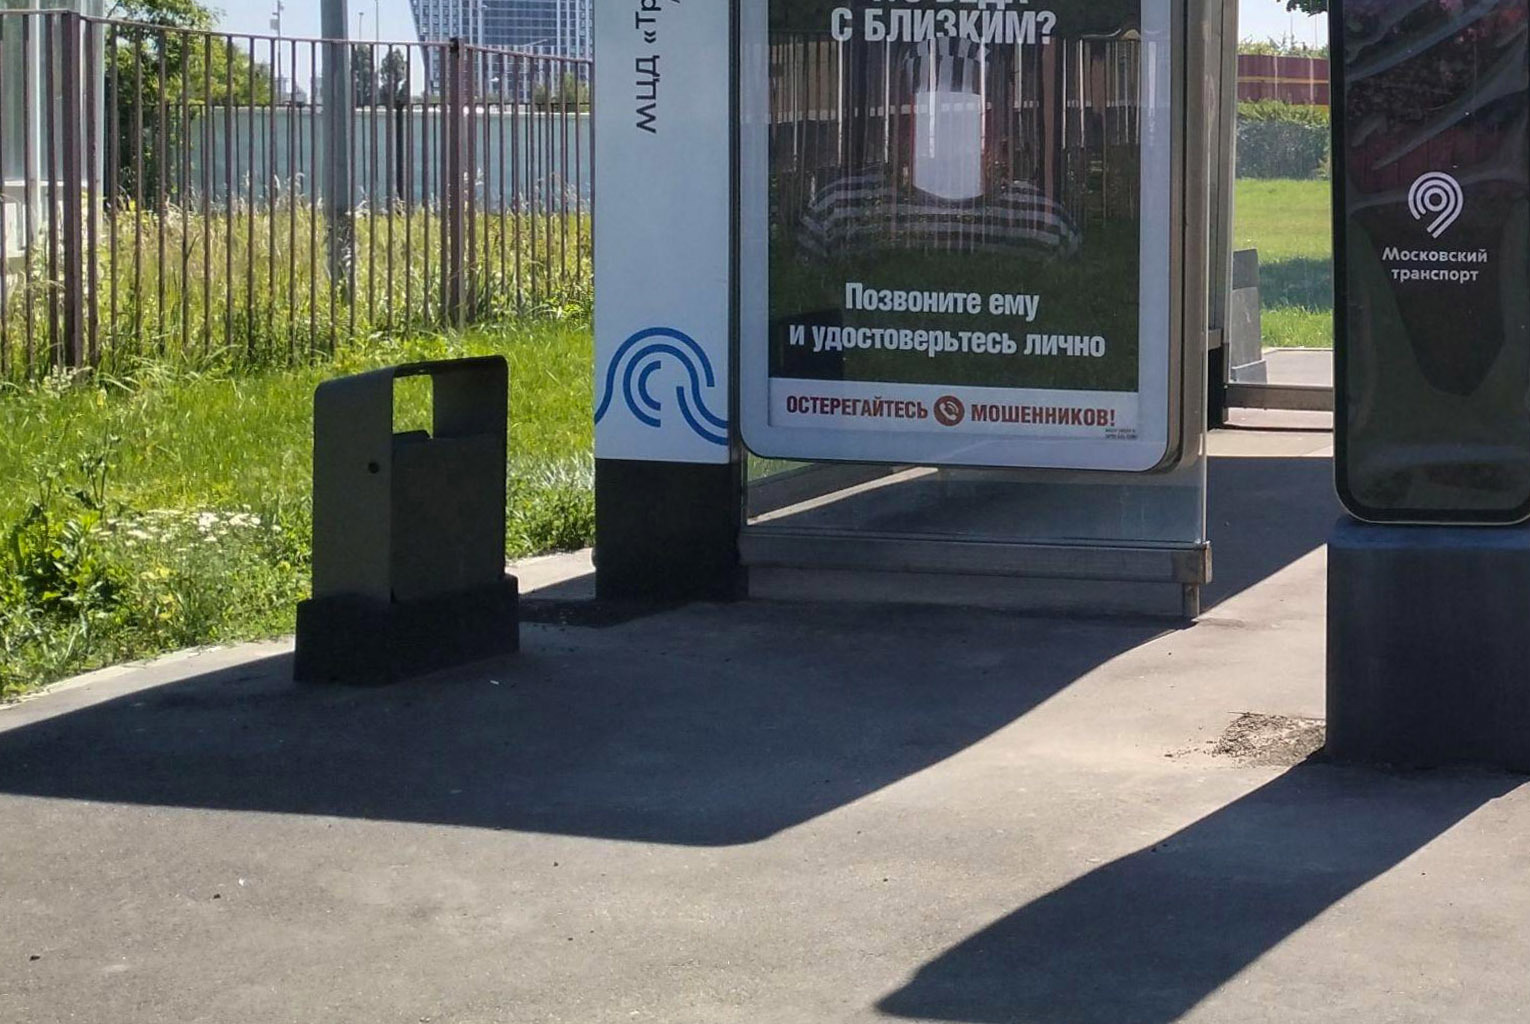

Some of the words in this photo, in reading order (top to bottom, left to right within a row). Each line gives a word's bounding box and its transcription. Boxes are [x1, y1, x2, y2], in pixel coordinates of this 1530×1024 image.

[831, 7, 853, 41] С
[864, 8, 1057, 45] БЛИЗКИМ?
[635, 55, 661, 134] МЦД
[1382, 246, 1488, 263] Московский
[1391, 268, 1479, 284] транспорт
[845, 281, 982, 315] Позвоните
[988, 293, 1040, 322] ему
[789, 324, 805, 346] и
[811, 325, 1017, 358] удостоверьтесь
[1023, 332, 1106, 358] лично
[786, 394, 928, 419] ОСТЕРЕГАЙТЕСЬ
[970, 403, 1117, 427] МОШЕННИКОВ!
